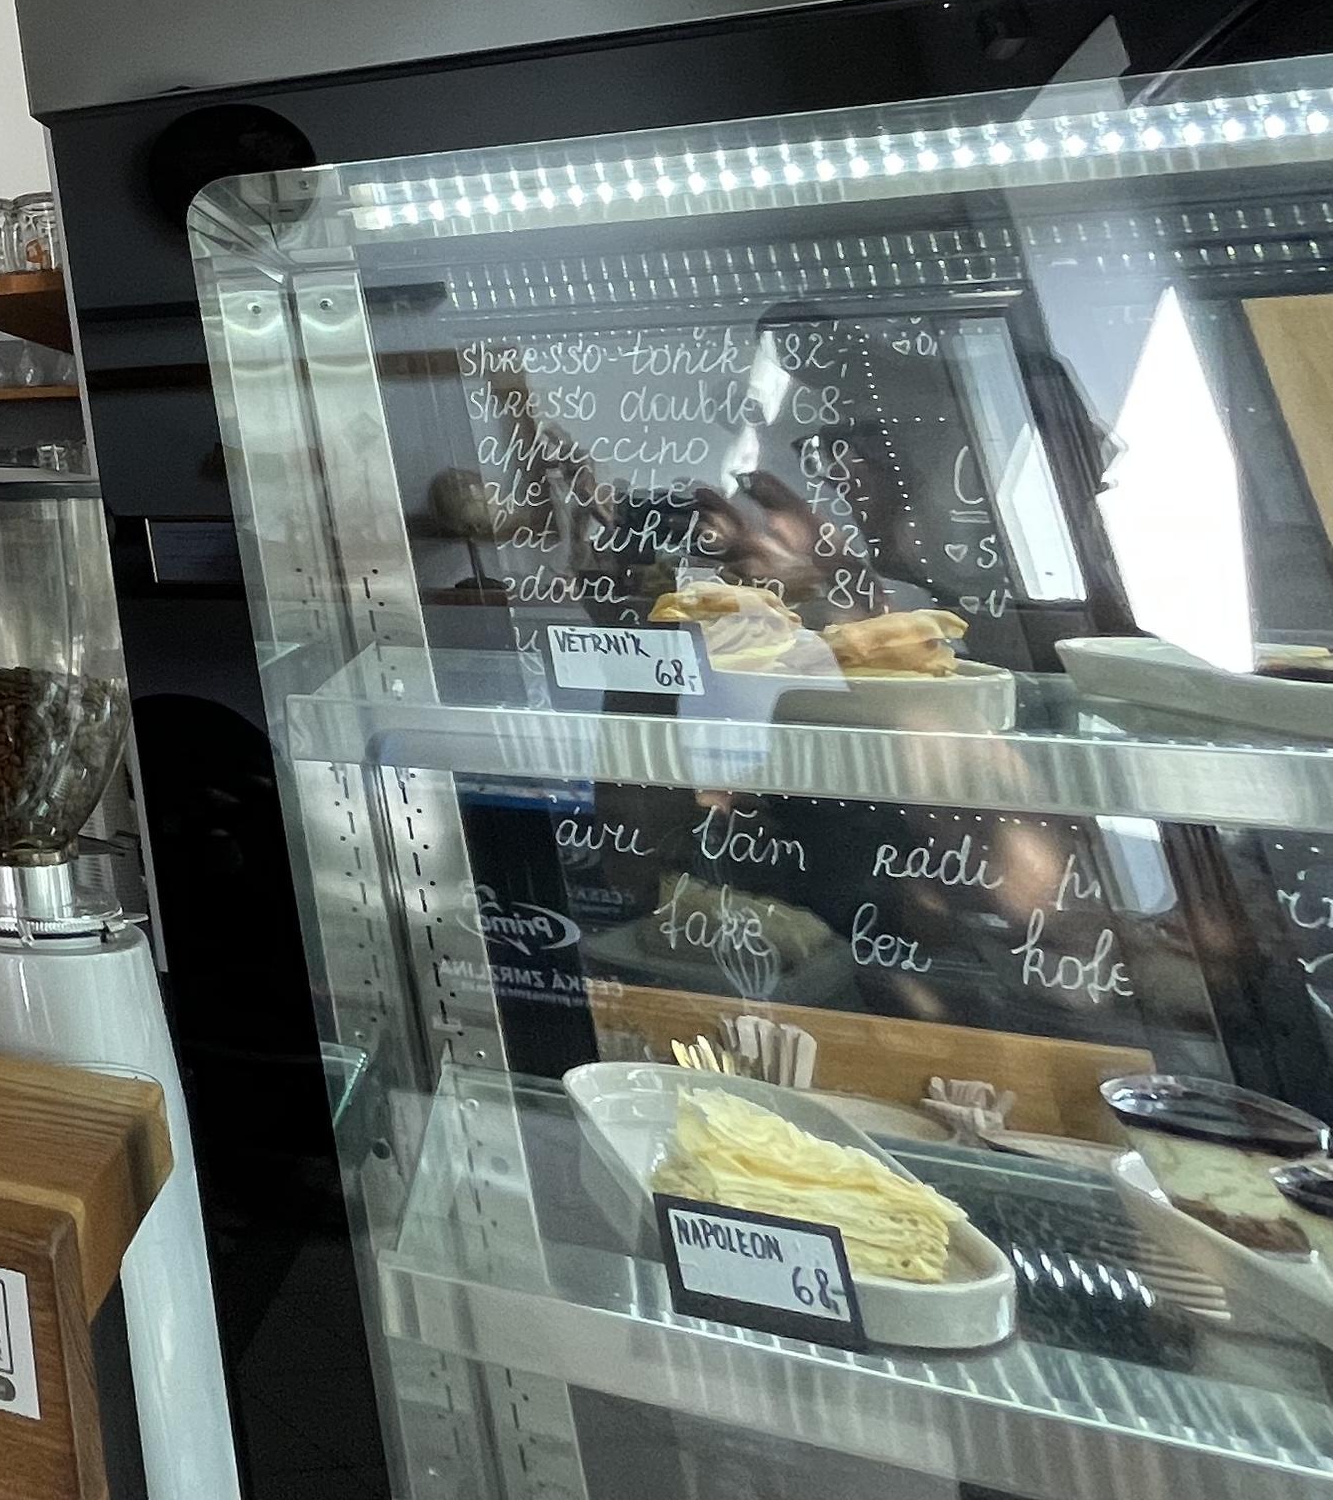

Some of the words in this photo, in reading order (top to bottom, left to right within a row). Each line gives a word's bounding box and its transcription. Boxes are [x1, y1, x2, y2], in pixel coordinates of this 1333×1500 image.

[554, 627, 651, 658] VĚTRNÍK
[851, 902, 933, 973] bez
[673, 1214, 784, 1263] NAPOLEON
